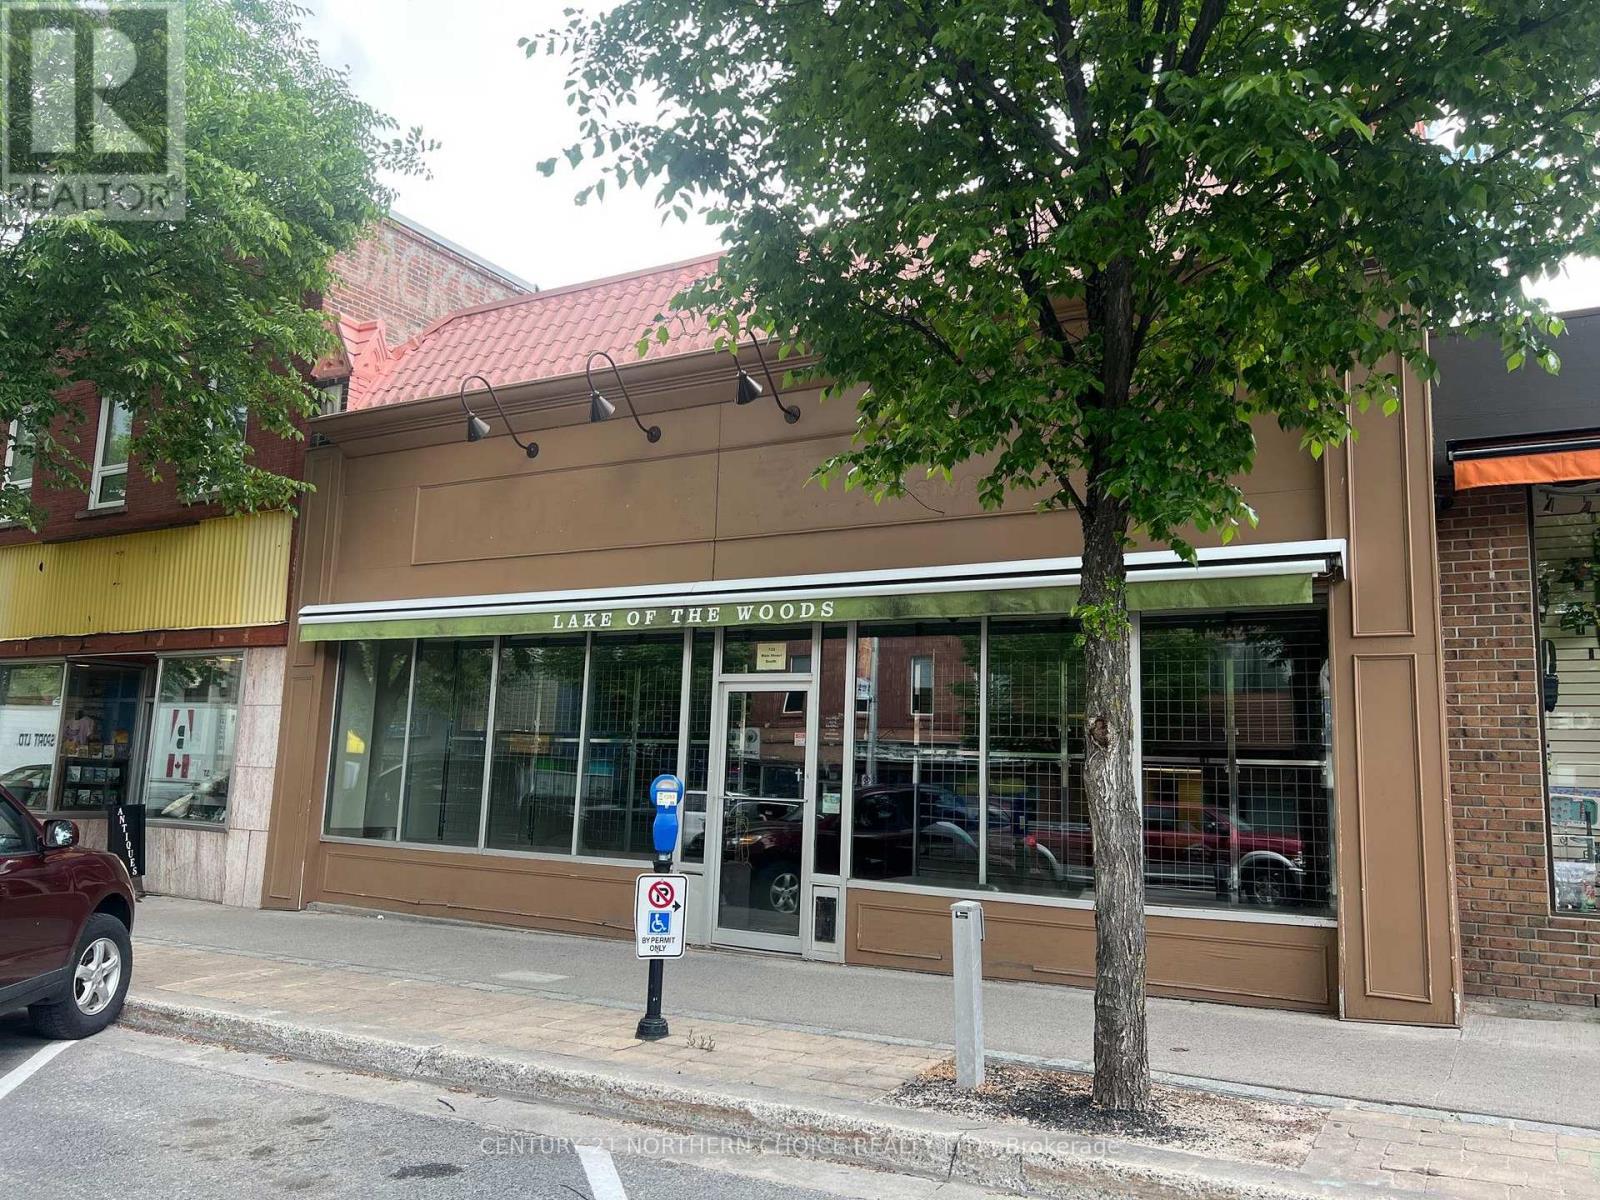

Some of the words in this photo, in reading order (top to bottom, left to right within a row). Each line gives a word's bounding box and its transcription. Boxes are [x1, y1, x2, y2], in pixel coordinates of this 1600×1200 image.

[553, 612, 612, 629] LAKE
[626, 610, 656, 626] OF
[671, 606, 720, 623] THE
[737, 601, 834, 620] WOODS
[117, 807, 138, 876] ANTIQUES
[641, 936, 651, 944] BY
[650, 936, 676, 944] PERMIT
[649, 944, 667, 952] ONLY
